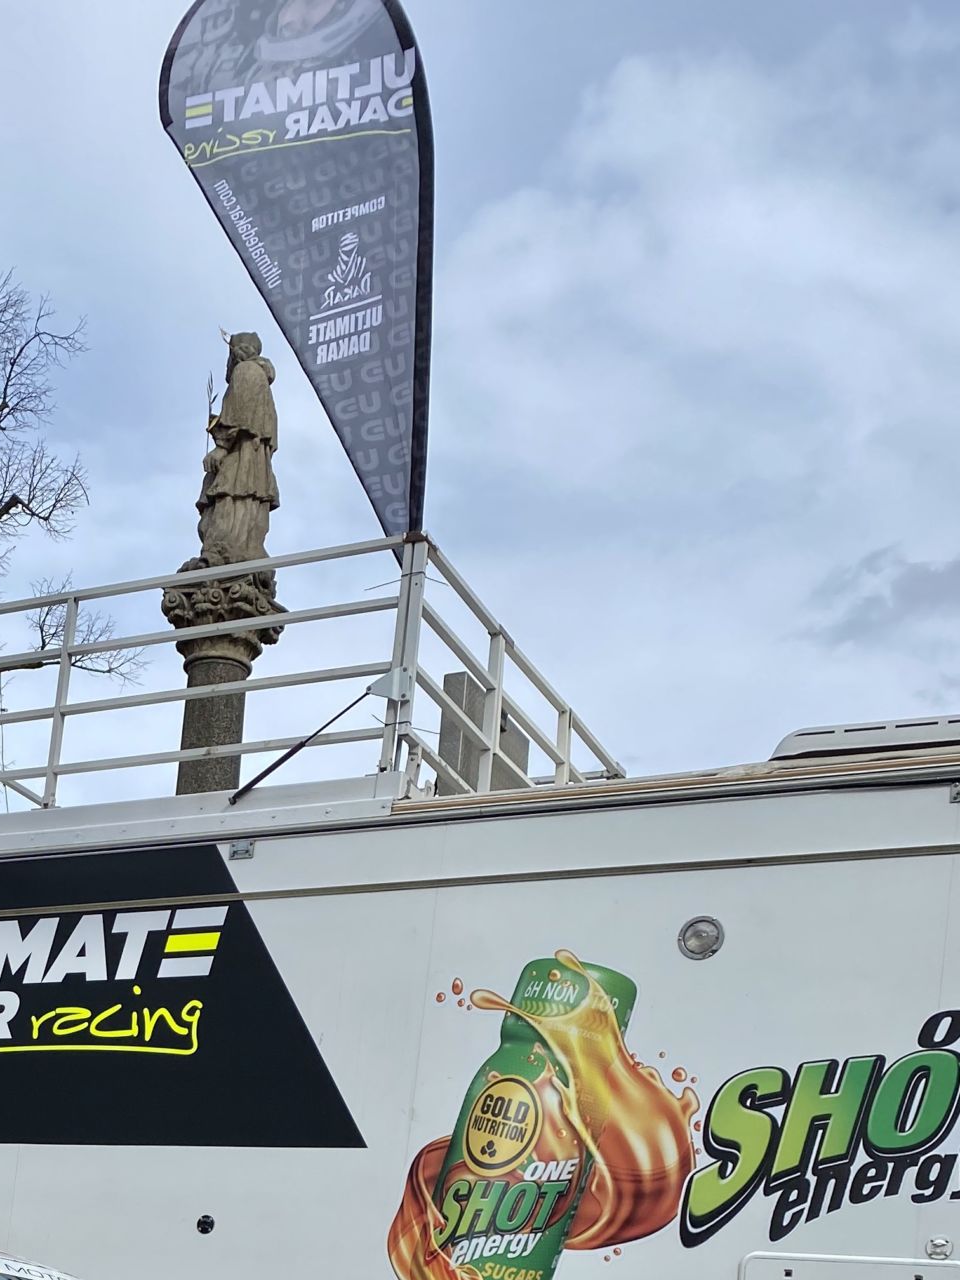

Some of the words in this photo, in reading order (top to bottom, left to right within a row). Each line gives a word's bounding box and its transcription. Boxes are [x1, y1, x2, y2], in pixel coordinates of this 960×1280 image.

[541, 983, 580, 1004] NON
[30, 985, 204, 1056] racing
[480, 1093, 530, 1124] GOLD
[471, 1115, 529, 1144] NUTRITION
[523, 1158, 580, 1181] ONE
[433, 1178, 570, 1250] SHOT
[768, 1153, 960, 1242] energ
[450, 1231, 544, 1266] energy
